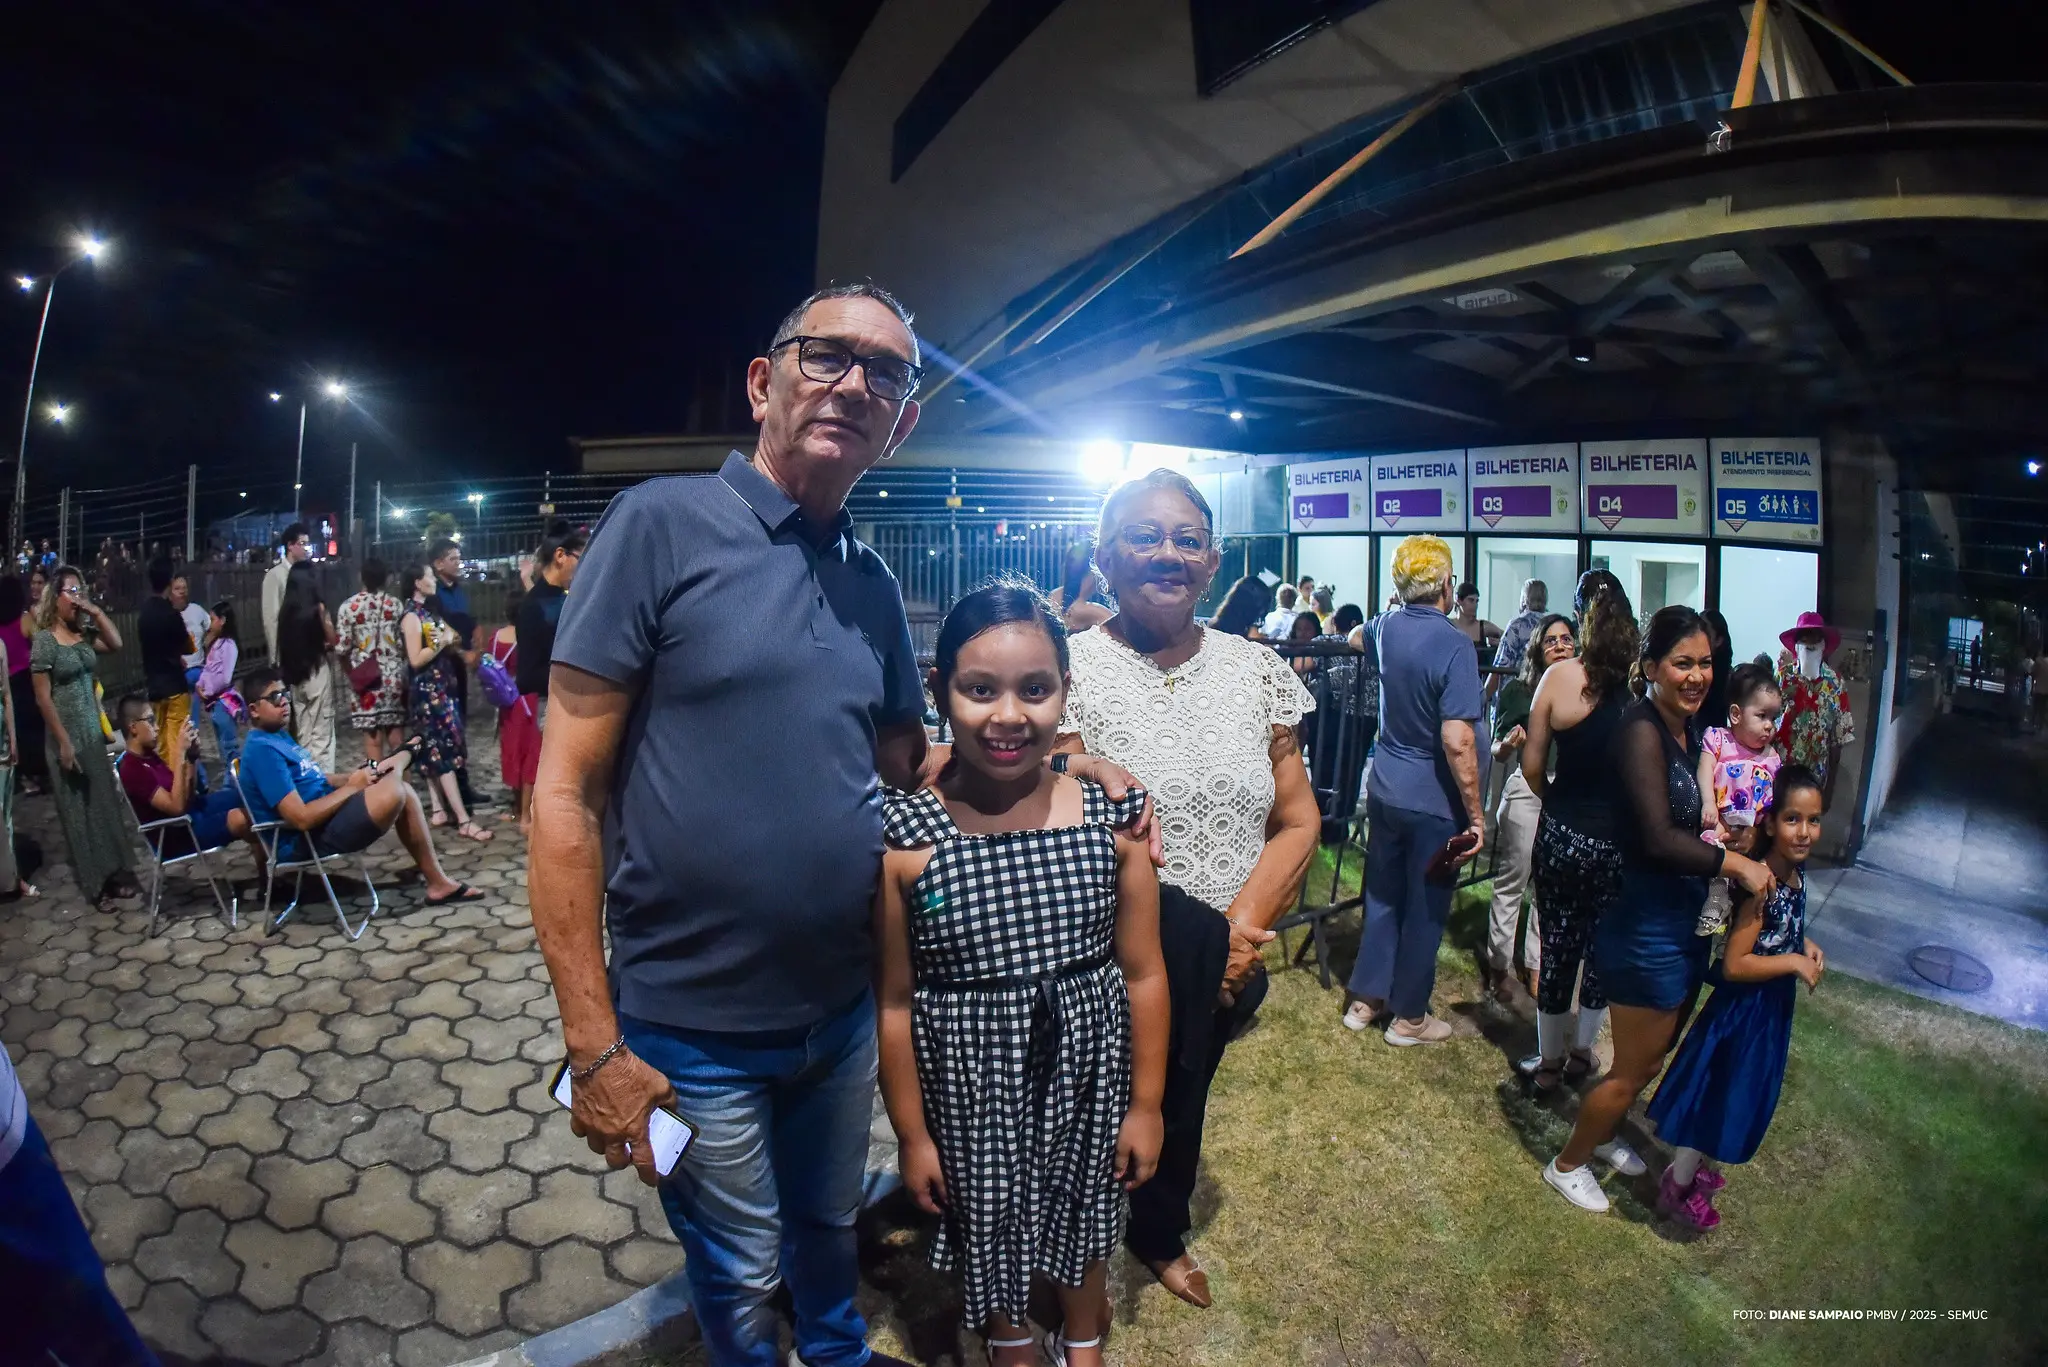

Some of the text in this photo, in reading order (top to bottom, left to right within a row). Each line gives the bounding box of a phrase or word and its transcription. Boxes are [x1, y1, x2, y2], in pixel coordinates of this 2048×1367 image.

[1475, 455, 1569, 475] BILHETERIA
[1590, 454, 1698, 472] BILHETERIA
[1721, 451, 1811, 466] BILHETERIA
[1294, 469, 1362, 486] BILHETERIA
[1377, 462, 1458, 480] BILHETERIA
[1767, 469, 1812, 477] PREFERENCIAL
[1299, 502, 1313, 516] 01
[1383, 499, 1401, 513] 02
[1482, 496, 1503, 512] 03
[1599, 495, 1622, 512] 04
[1726, 499, 1746, 515] 05
